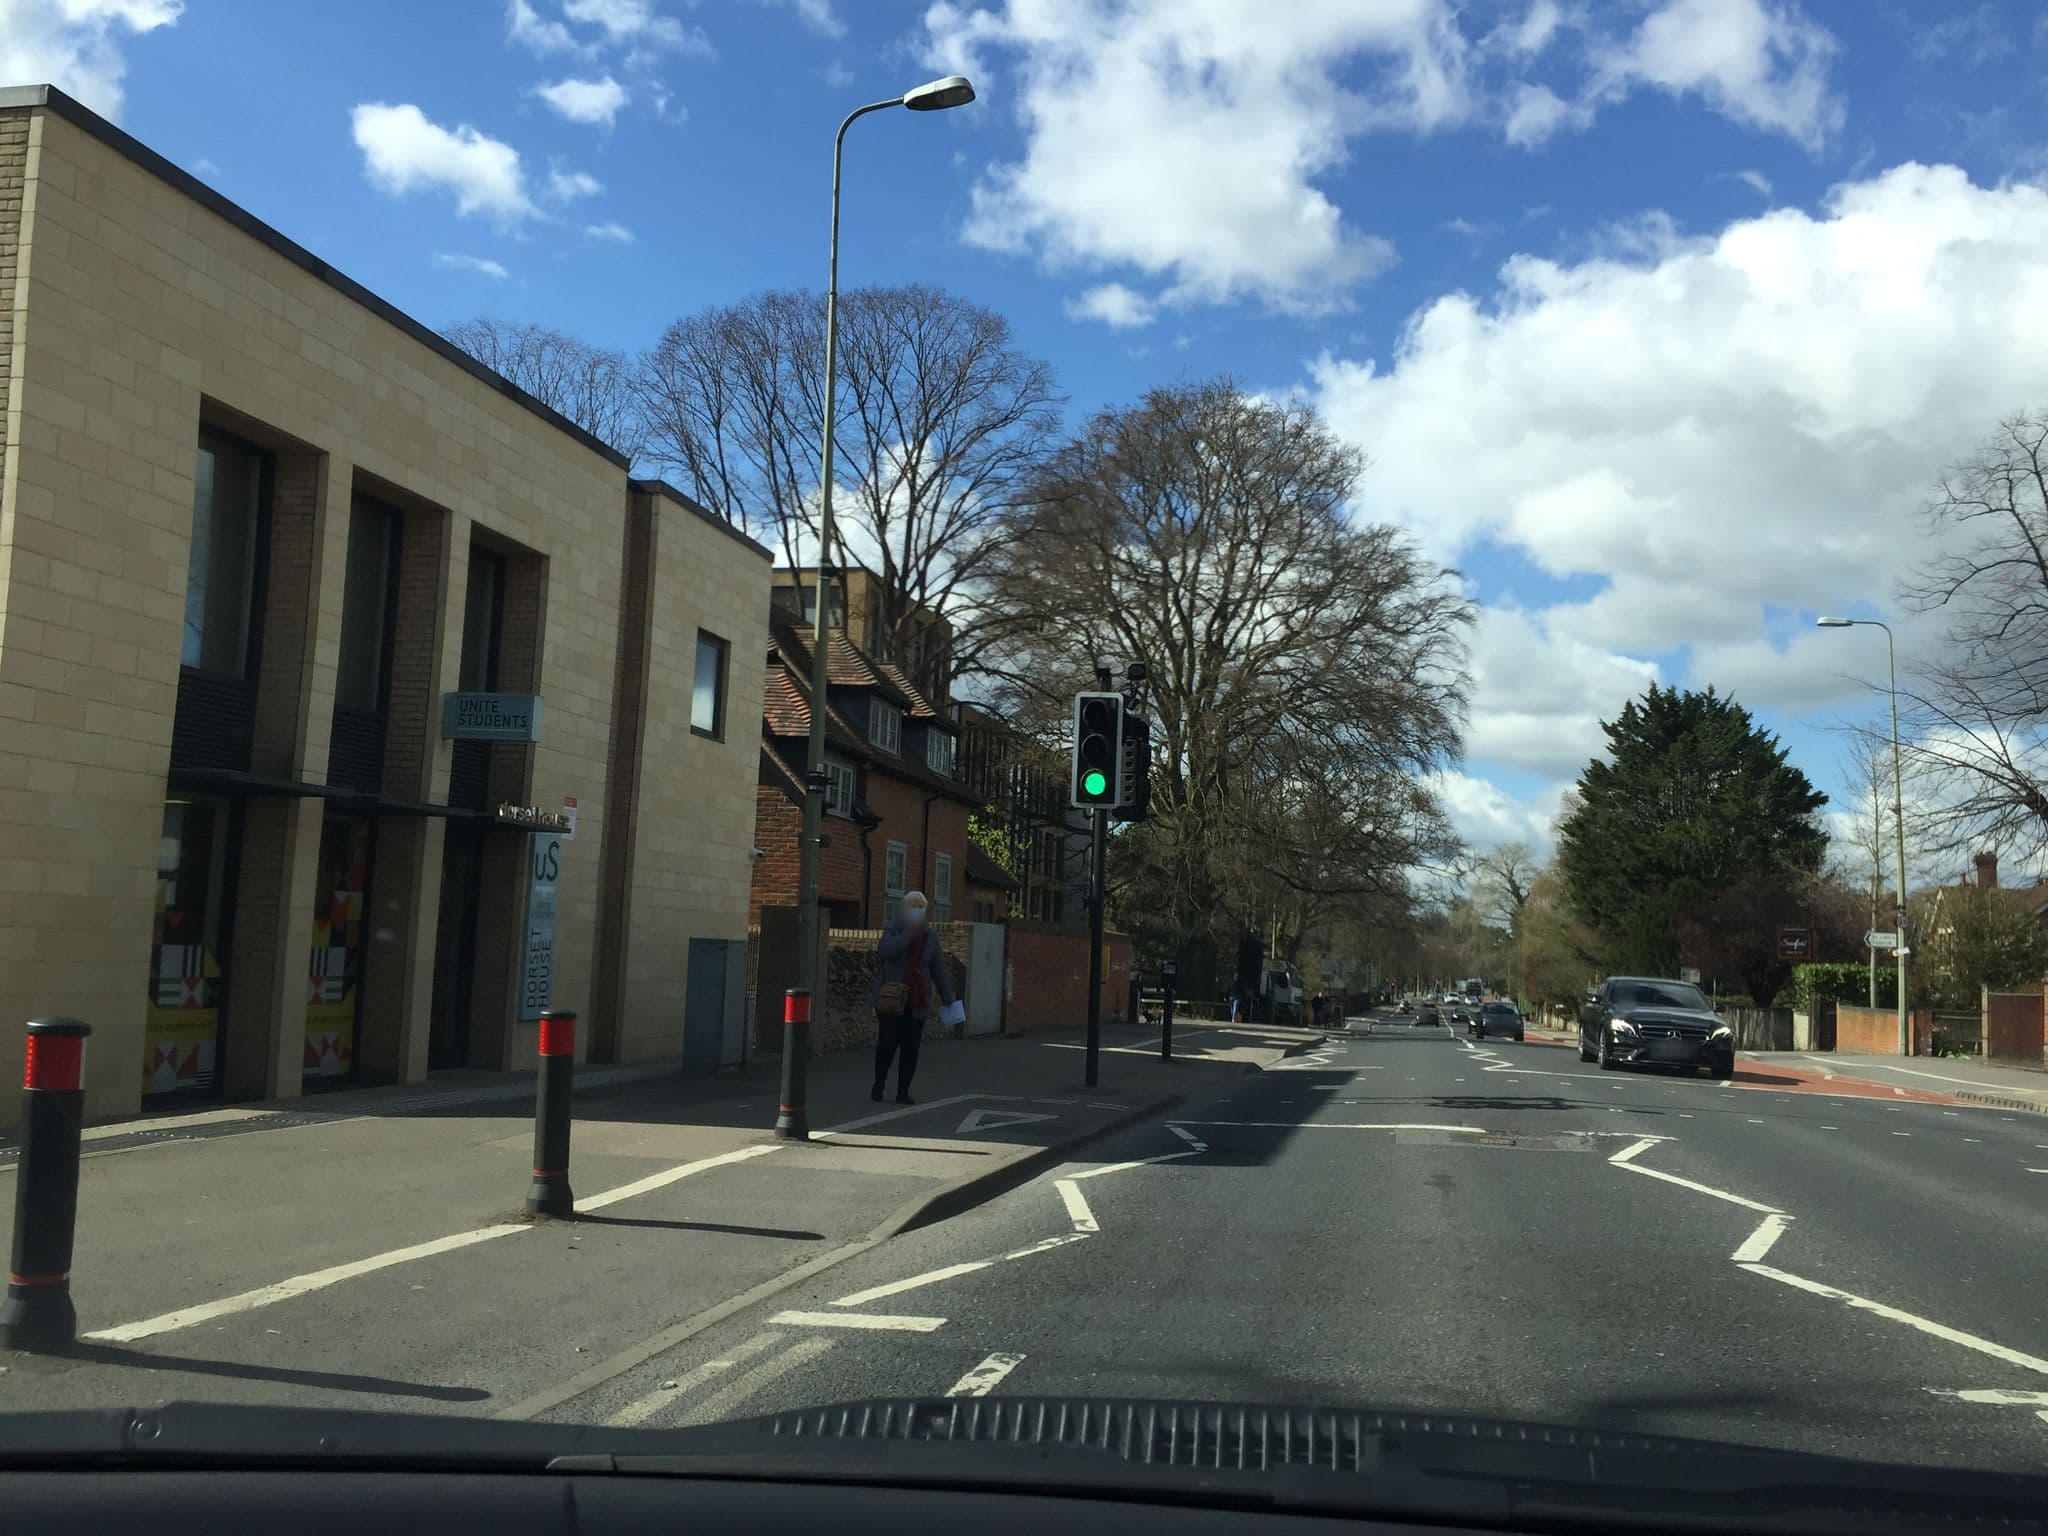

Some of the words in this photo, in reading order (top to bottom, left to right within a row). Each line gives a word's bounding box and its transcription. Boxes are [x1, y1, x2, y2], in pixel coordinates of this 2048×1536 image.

[458, 711, 529, 729] STUDENTS
[459, 699, 500, 713] UNITE
[526, 928, 541, 1008] DORSET
[537, 940, 552, 1008] HOUSE
